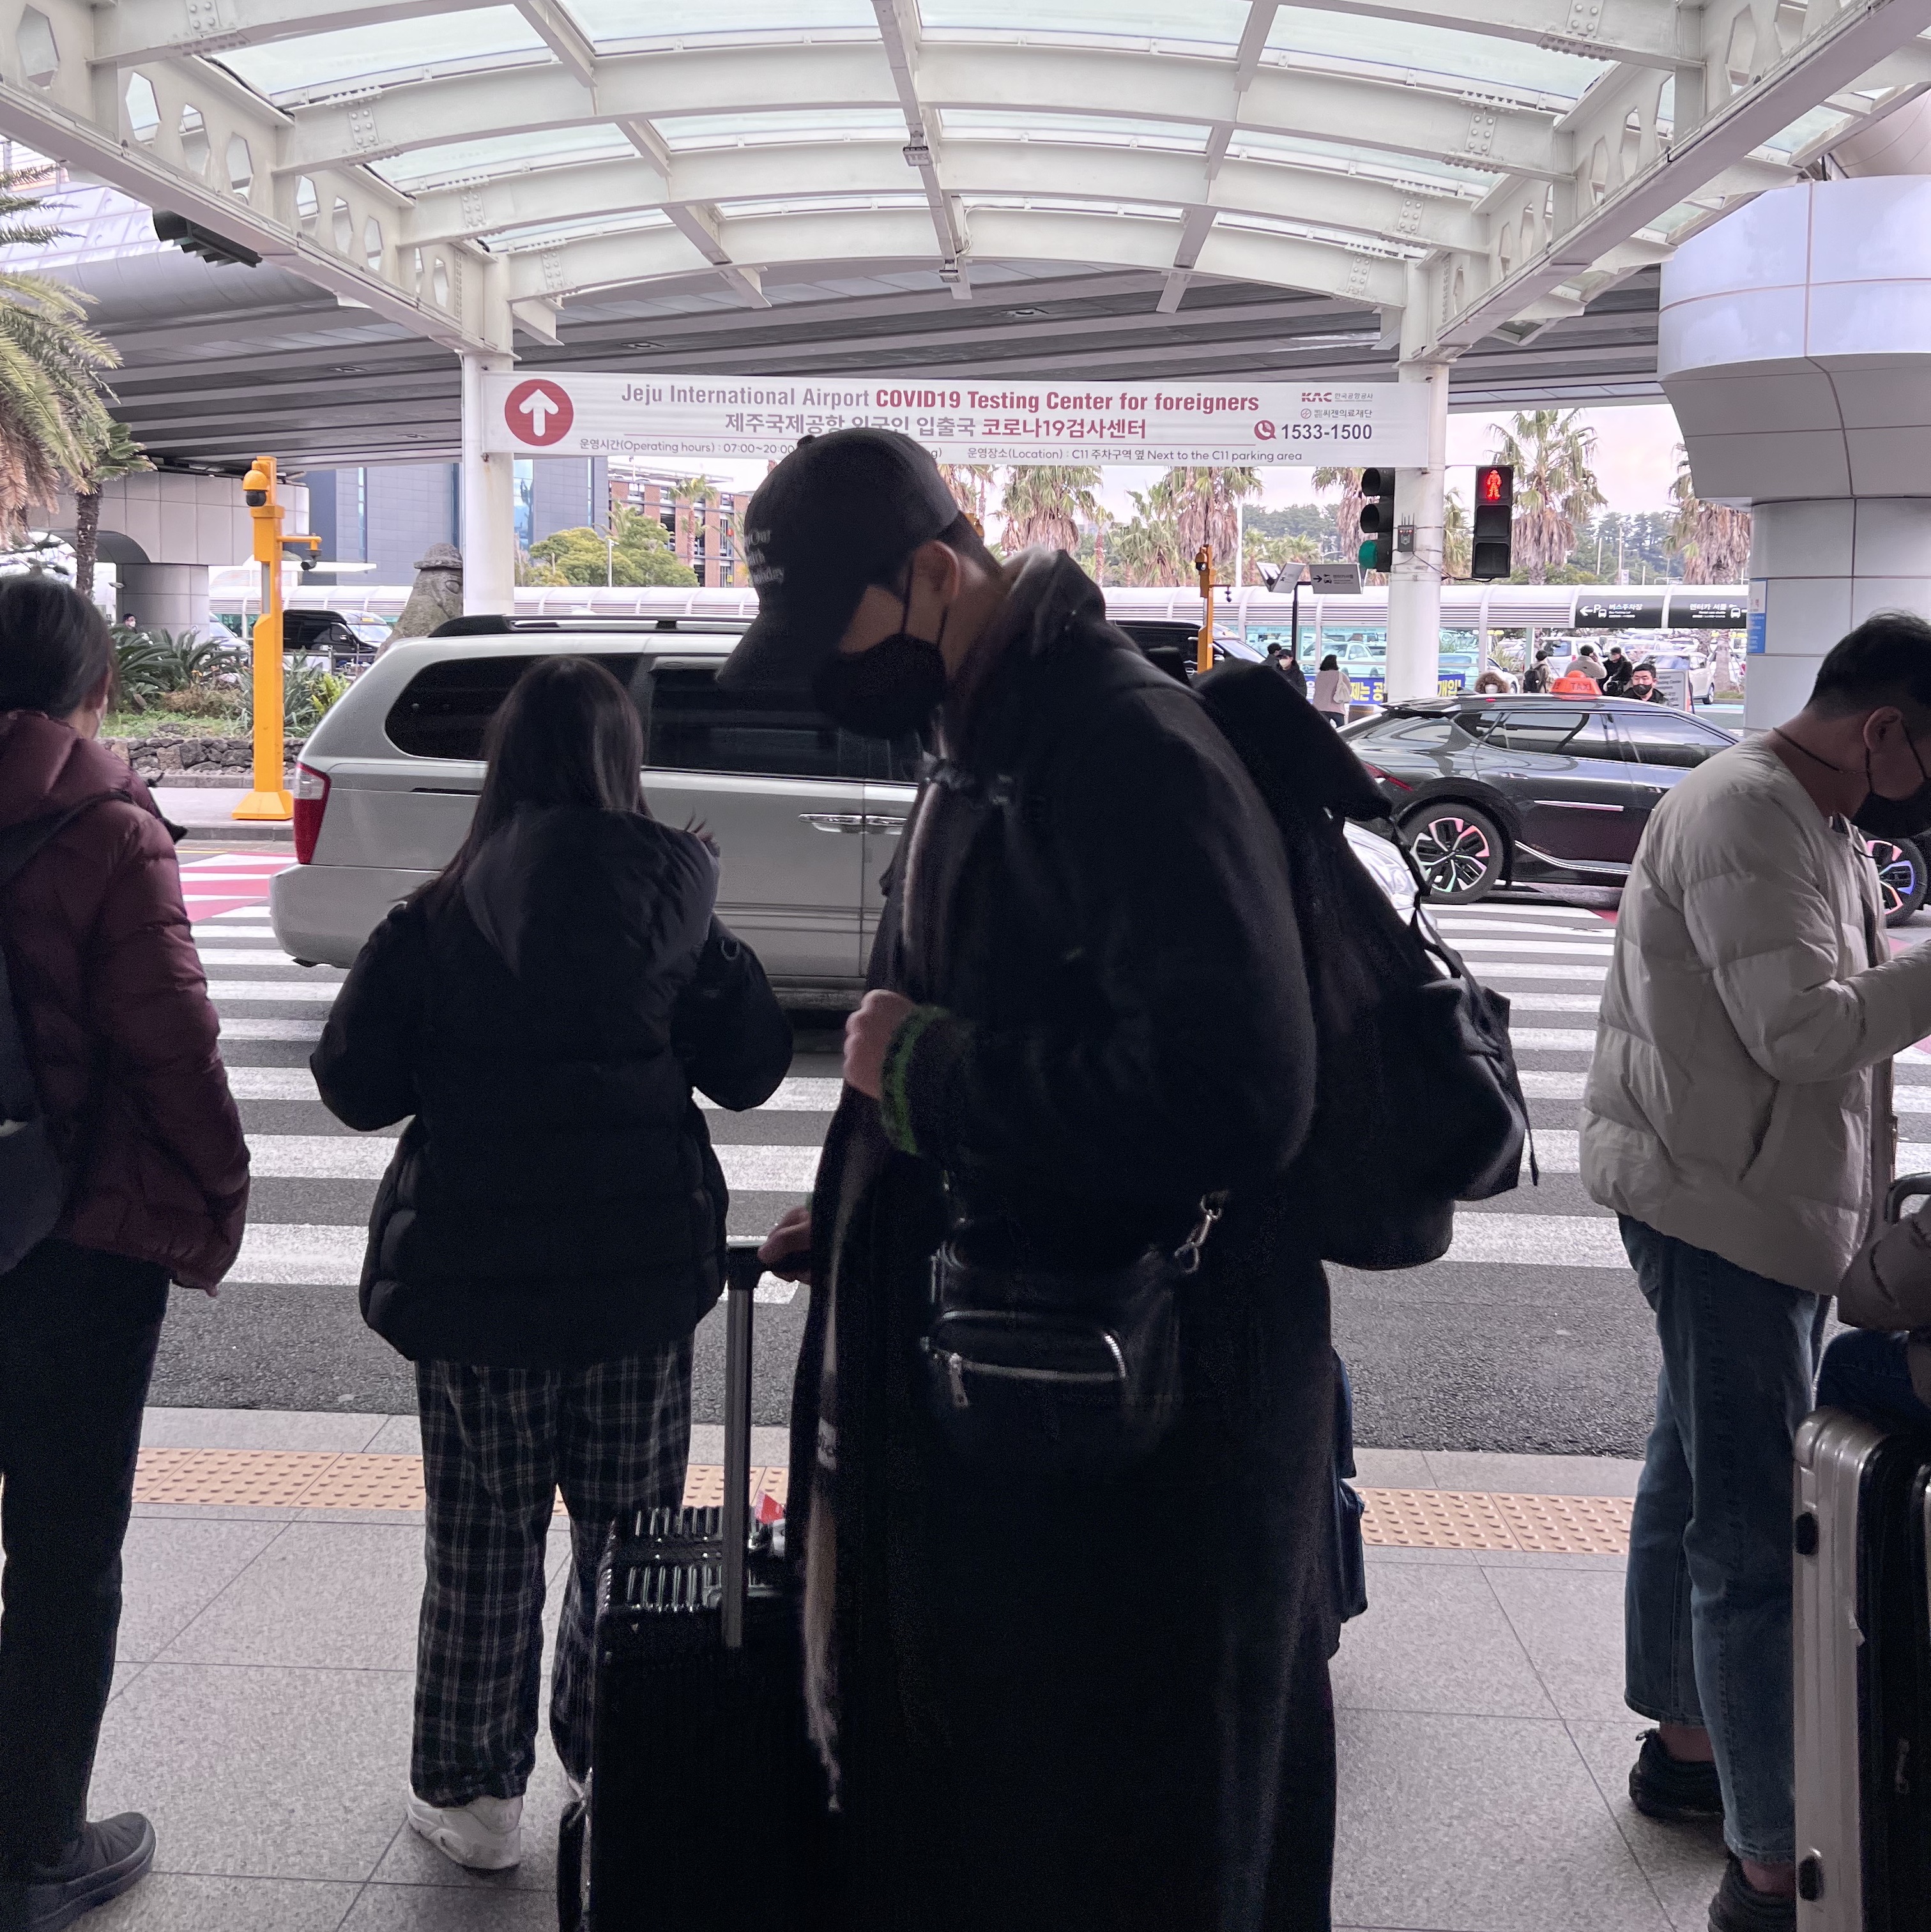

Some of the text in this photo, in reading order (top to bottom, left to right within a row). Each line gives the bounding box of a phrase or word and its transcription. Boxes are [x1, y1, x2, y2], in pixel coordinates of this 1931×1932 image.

[622, 384, 1259, 414] Jeju International Airport COVID19 Testing Center for foreigners
[1302, 392, 1332, 402] KAC
[725, 413, 846, 436] 제주국제공항
[917, 416, 976, 437] 입출국
[981, 417, 1147, 439] 코로나19검사센터
[1281, 424, 1373, 441] 1533-1500
[579, 439, 678, 453] 운영시간(Operating
[681, 441, 715, 453] hours)
[724, 443, 795, 453] 07:00~20:00
[967, 447, 1063, 460] 운영장소(Location)
[1072, 450, 1088, 459] C11
[1091, 449, 1133, 460] 주차구역
[1135, 449, 1145, 460] 옆
[1148, 450, 1174, 460] Next
[1177, 451, 1188, 460] to
[1191, 450, 1209, 460] the
[1212, 450, 1229, 460] C11
[1232, 450, 1274, 462] parking
[1276, 452, 1302, 460] area
